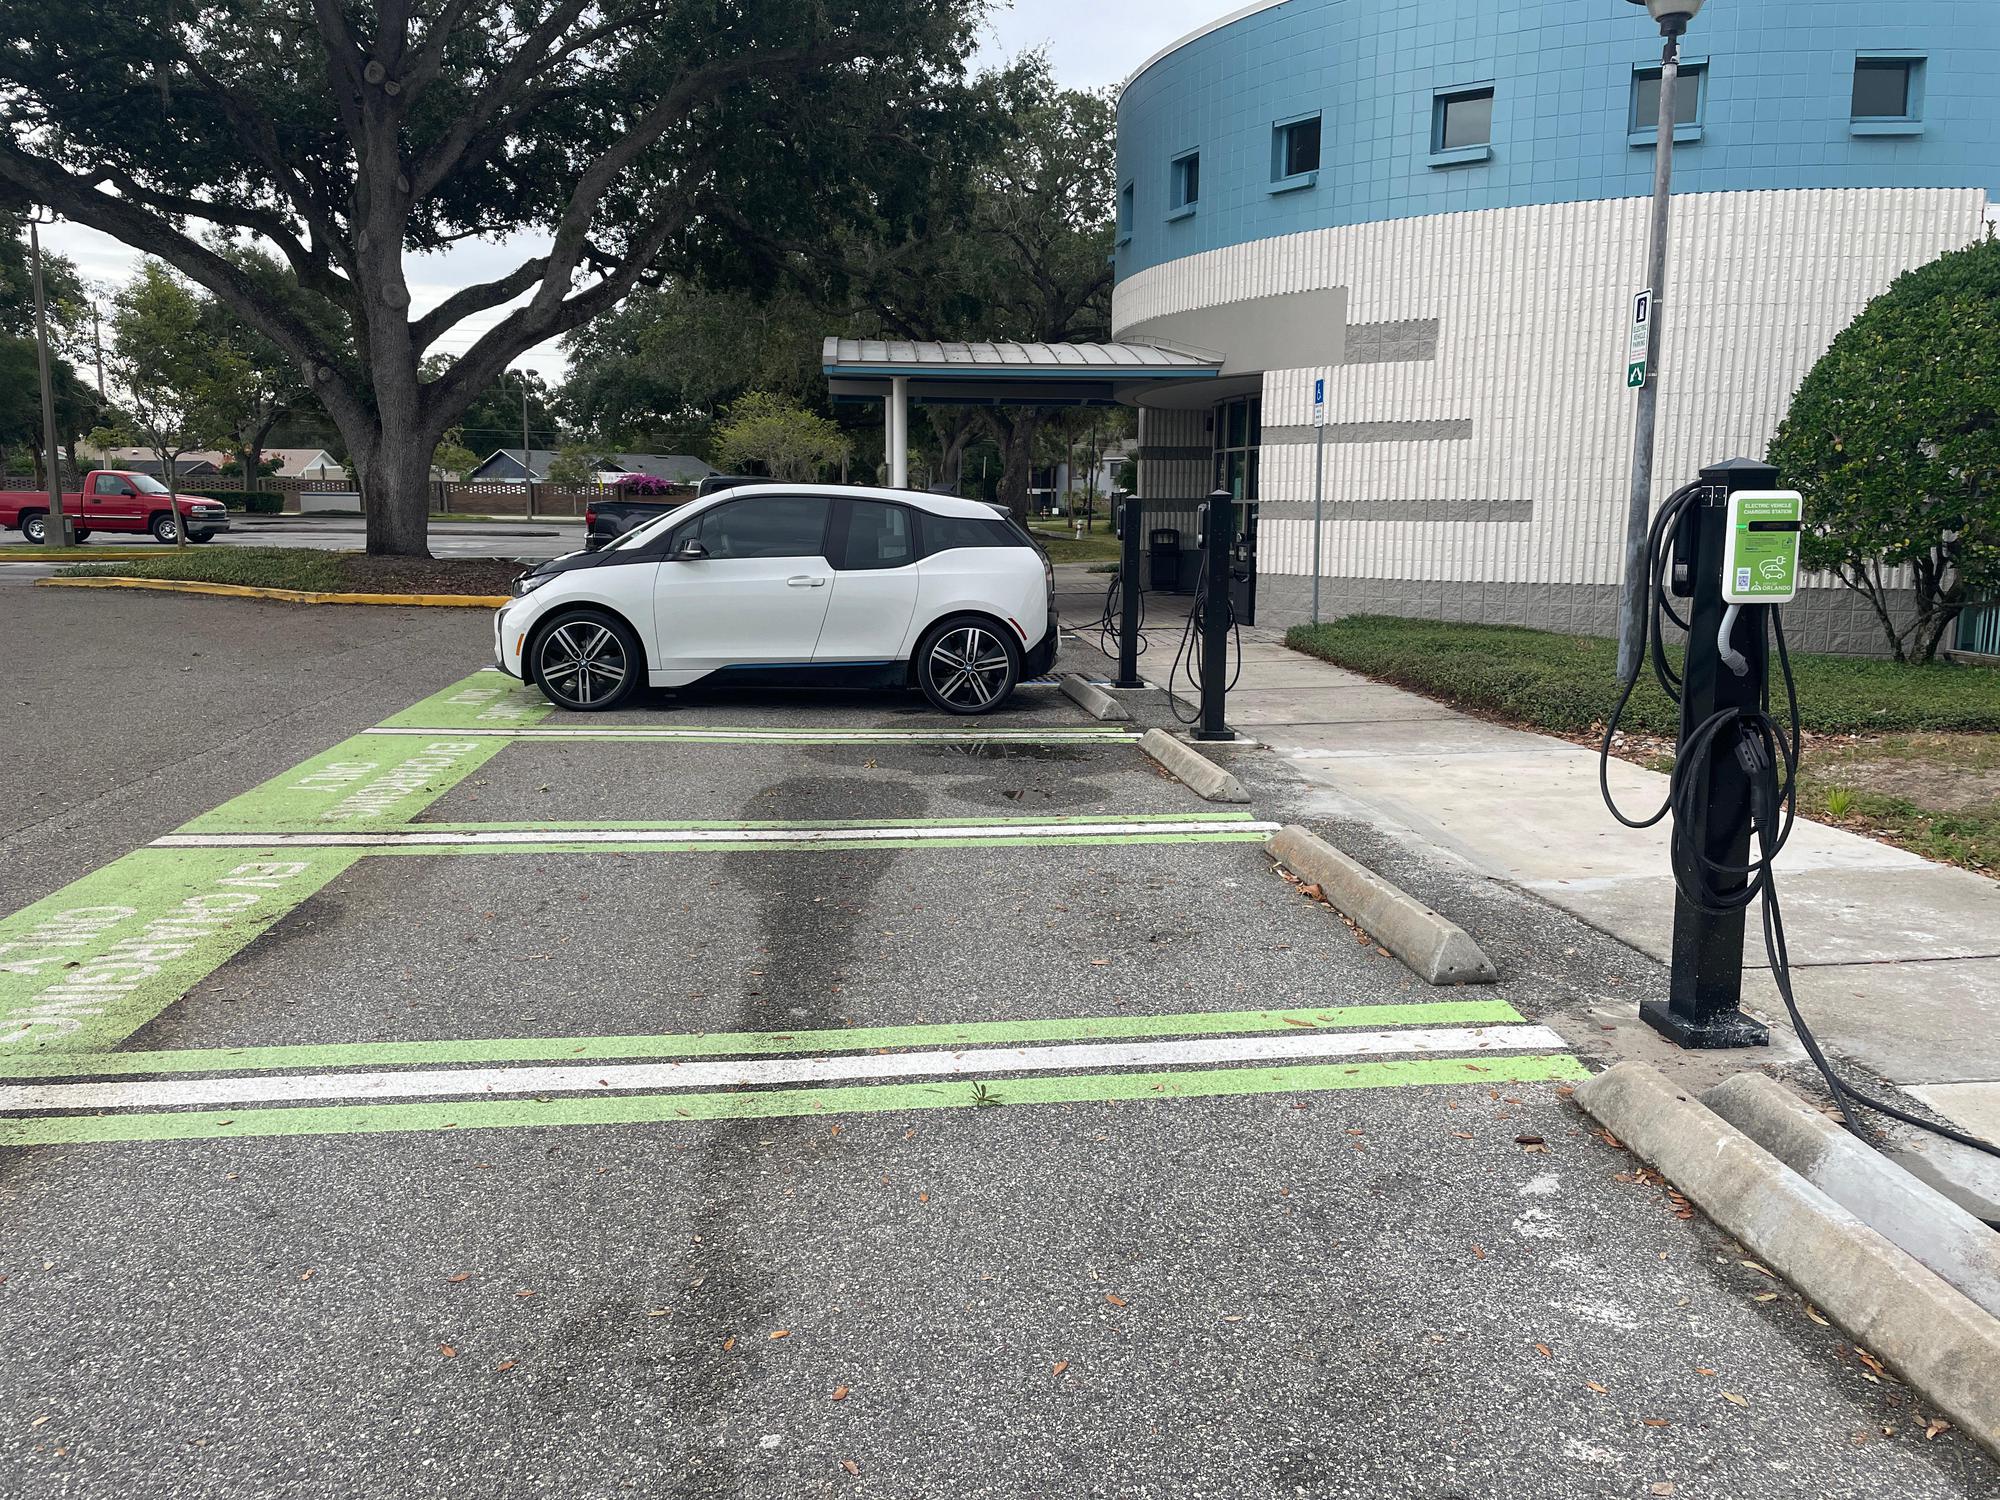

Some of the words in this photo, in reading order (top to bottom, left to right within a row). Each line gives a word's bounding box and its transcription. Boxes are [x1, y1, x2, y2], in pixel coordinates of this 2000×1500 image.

[420, 742, 480, 756] EV
[287, 762, 379, 792] ONLY
[320, 757, 457, 819] CHARGING
[216, 862, 312, 888] EV
[0, 893, 262, 1043] CHARGING
